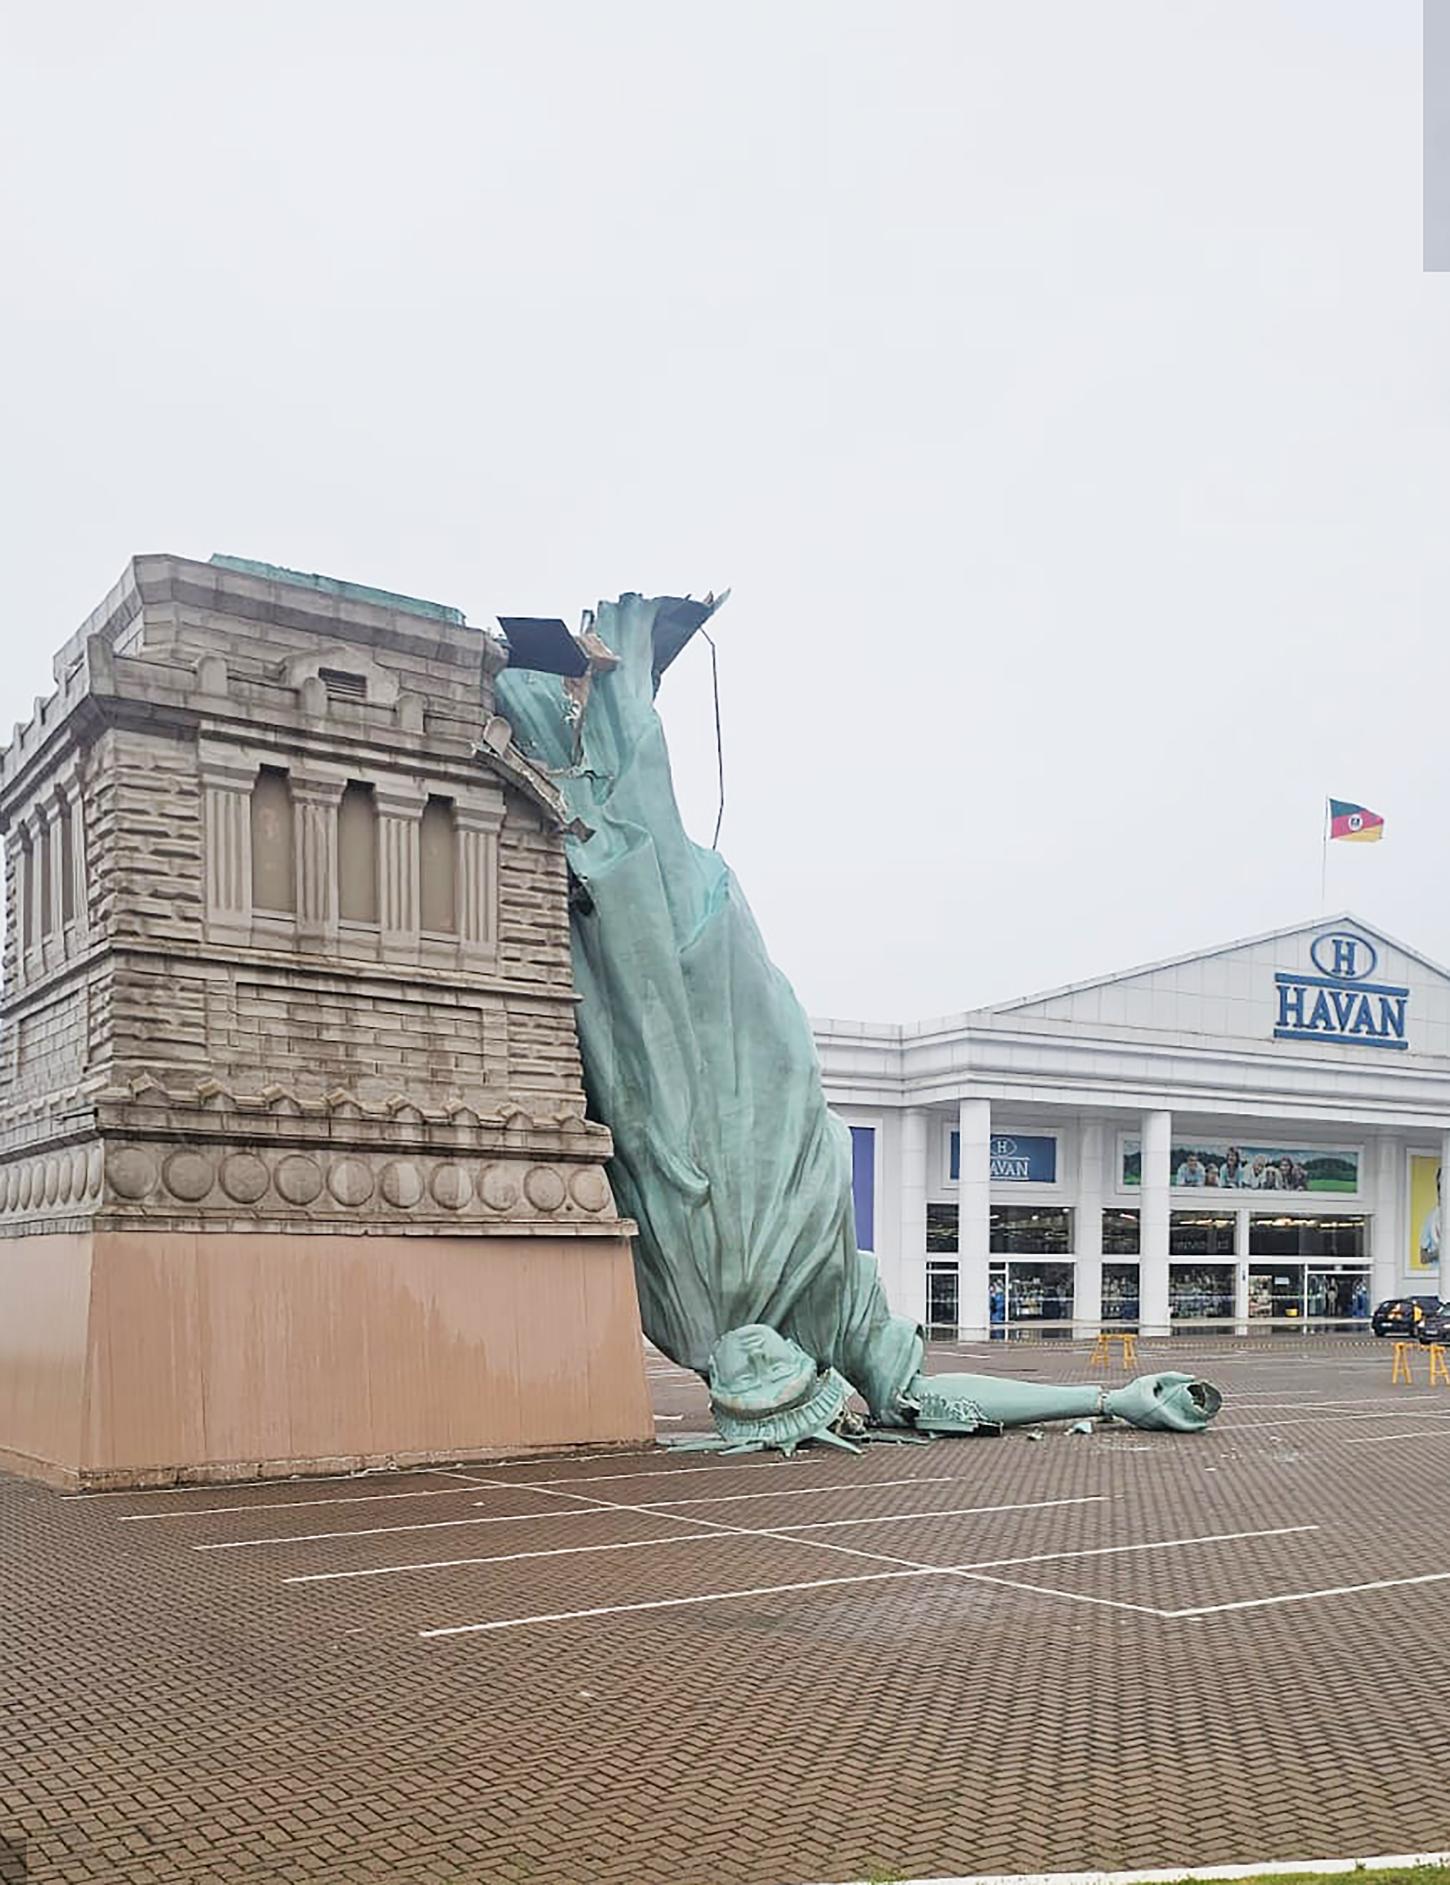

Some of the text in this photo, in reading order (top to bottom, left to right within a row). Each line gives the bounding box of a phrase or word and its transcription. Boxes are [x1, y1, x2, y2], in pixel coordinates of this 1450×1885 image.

[1331, 938, 1357, 976] H
[1275, 984, 1408, 1038] HAVAN
[997, 1140, 1007, 1153] H
[990, 1160, 1028, 1175] AVAN
